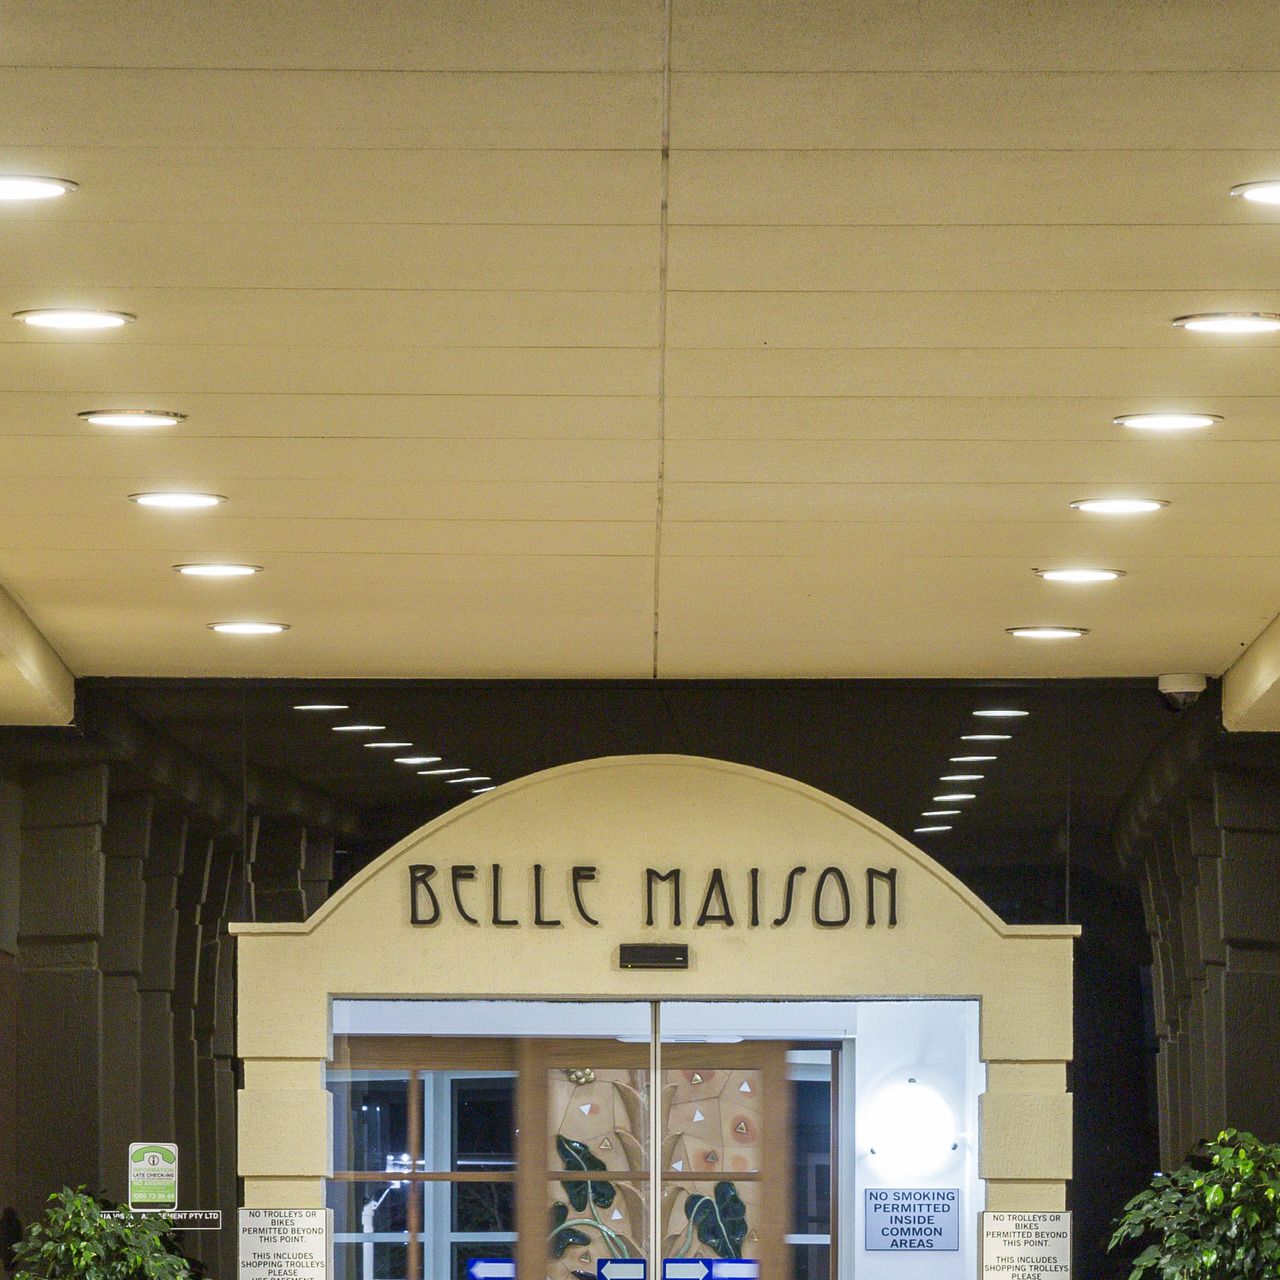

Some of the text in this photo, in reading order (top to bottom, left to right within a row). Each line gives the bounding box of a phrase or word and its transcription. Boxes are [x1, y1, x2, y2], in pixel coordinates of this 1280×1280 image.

[409, 864, 898, 928] BELLE MAISON
[869, 1191, 955, 1201] NO SMOKING
[874, 1203, 951, 1213] PERMITTED
[204, 1212, 219, 1220] LTD
[249, 1210, 317, 1218] NO TROLLEYS OR
[992, 1214, 1061, 1222] NO TROLLEYS OR
[890, 1215, 935, 1225] INSIDE
[242, 1227, 324, 1235] PERMITTED BEYOND
[881, 1227, 943, 1237] COMMON
[986, 1231, 1067, 1239] PERMITTED BEYOND
[890, 1239, 934, 1249] AREAS
[1003, 1239, 1051, 1247] THIS POINT.
[252, 1252, 314, 1260] THIS INCLUDES
[985, 1264, 1069, 1272] SHOPPING TROLLEYS
